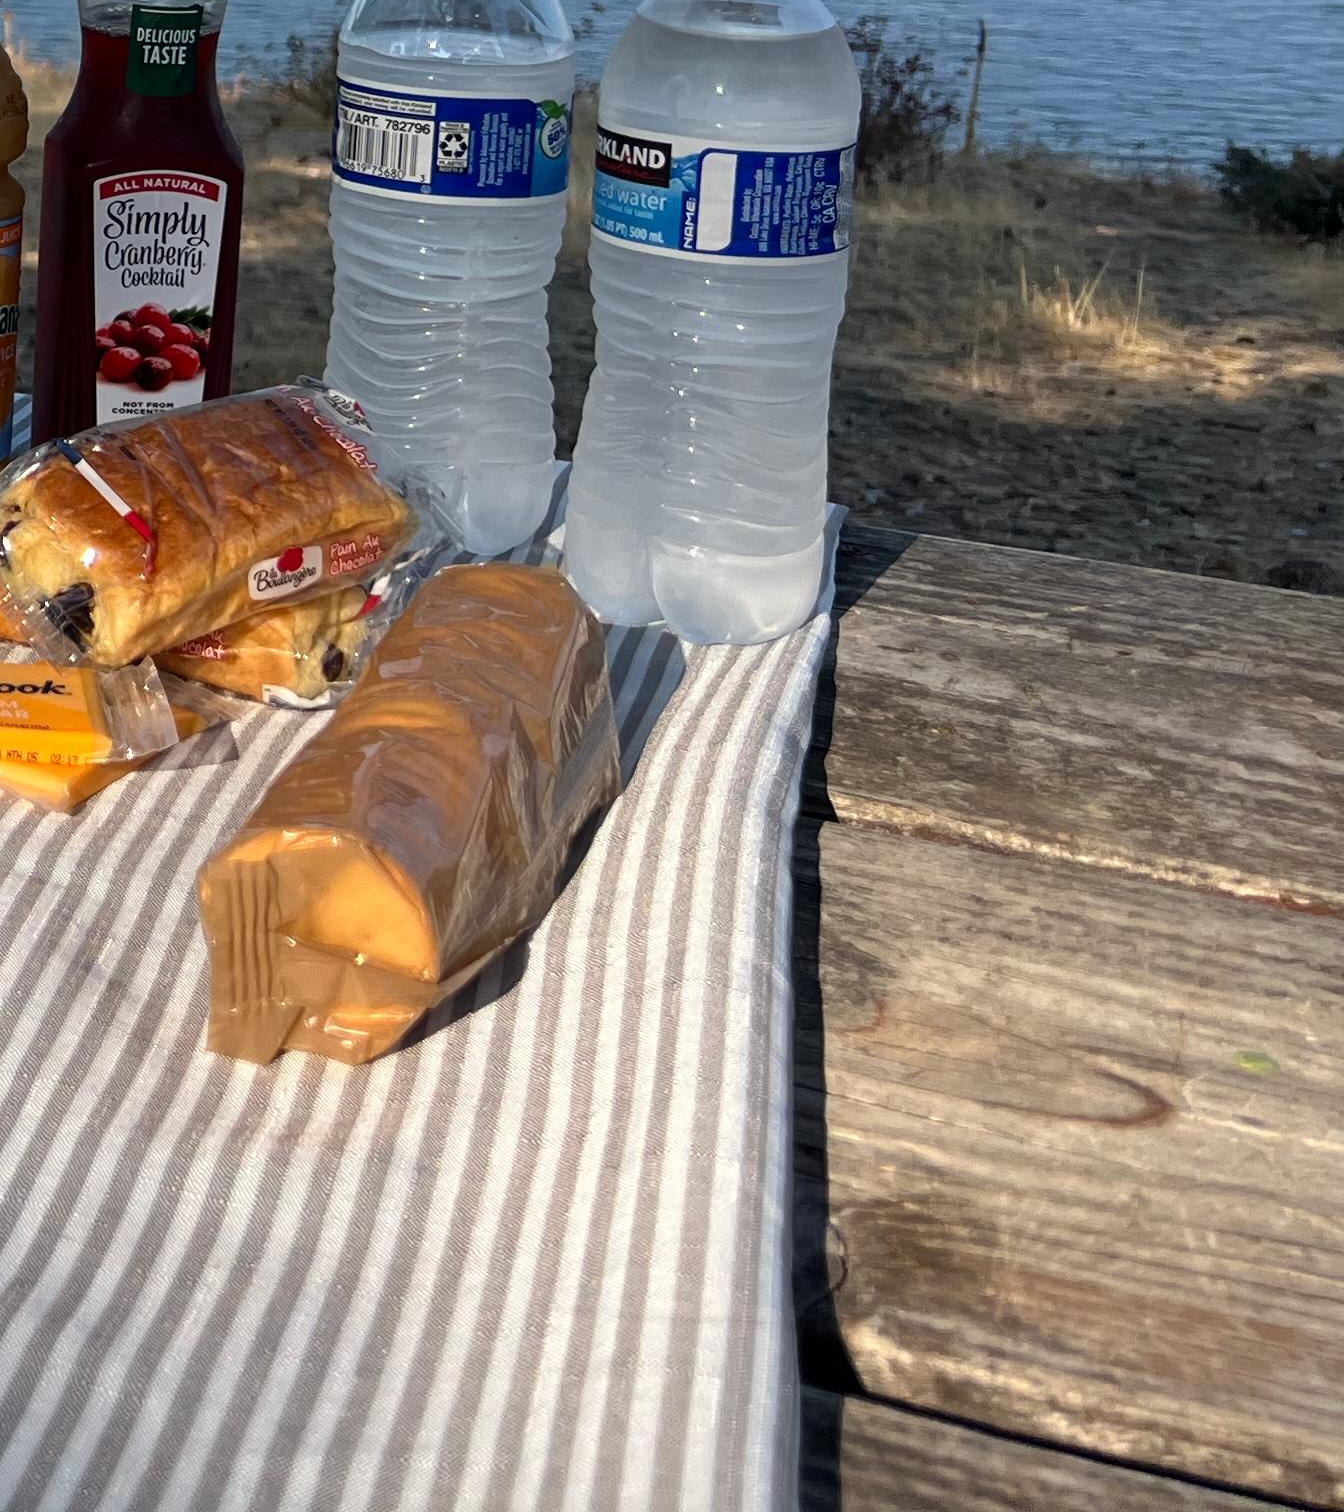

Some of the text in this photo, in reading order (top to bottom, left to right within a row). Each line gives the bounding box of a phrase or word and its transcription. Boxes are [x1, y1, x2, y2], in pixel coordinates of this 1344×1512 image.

[136, 26, 196, 45] DELICIOUS
[142, 44, 187, 66] TASTE
[385, 118, 431, 135] 782796
[113, 178, 207, 194] ALL NATURAL
[617, 187, 668, 211] water
[822, 185, 837, 223] CA CRV
[103, 198, 210, 248] Simply
[629, 223, 648, 241] 500
[683, 197, 697, 249] NAME:
[104, 238, 203, 275] Cranberry
[121, 267, 185, 289] Cocktail
[122, 400, 175, 409] NOT FROM
[330, 534, 380, 559] Pain Au
[331, 548, 383, 576] Chocolat
